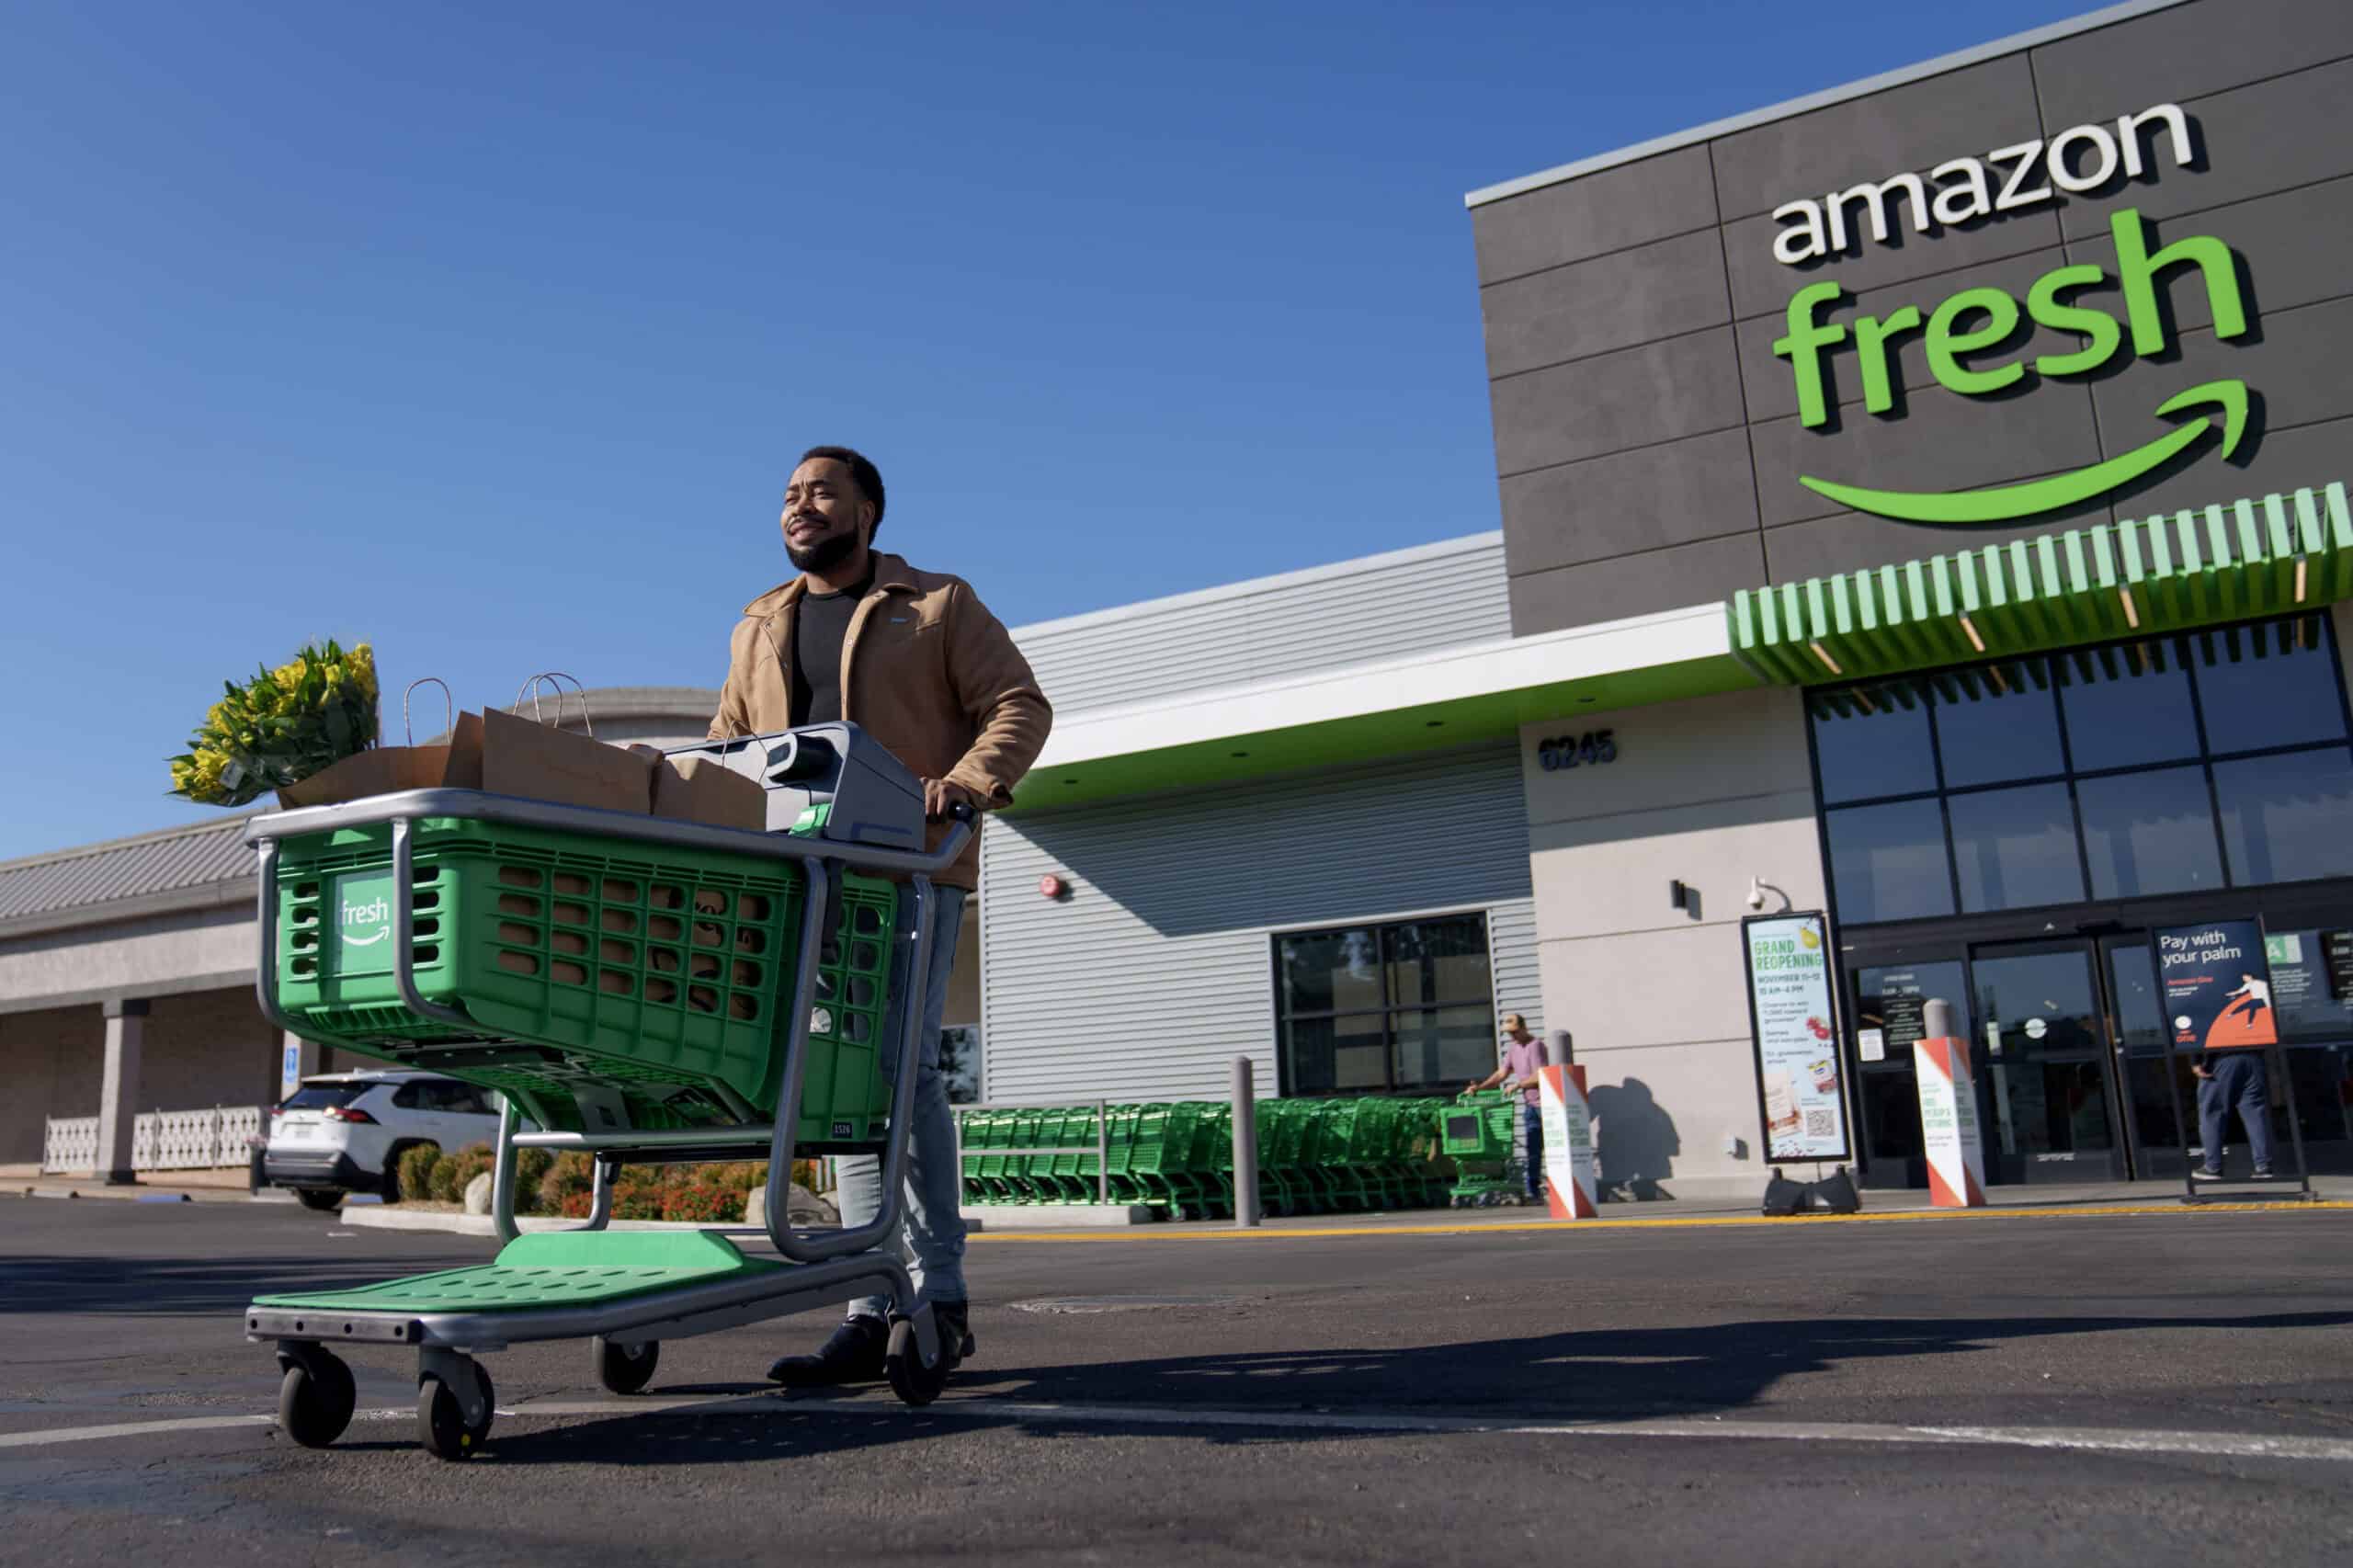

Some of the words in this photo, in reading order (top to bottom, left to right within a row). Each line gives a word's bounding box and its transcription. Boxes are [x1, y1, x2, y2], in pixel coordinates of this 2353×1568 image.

[1773, 103, 2193, 264] amazon
[1772, 208, 2246, 427] fresh
[1539, 728, 1618, 772] 6245
[340, 896, 388, 926] fresh
[1755, 939, 1794, 955] GRAND
[2160, 936, 2188, 950] Pay
[2191, 930, 2226, 947] with
[1756, 953, 1823, 971] REOPENING
[2163, 950, 2198, 969] your
[2201, 945, 2242, 963] palm
